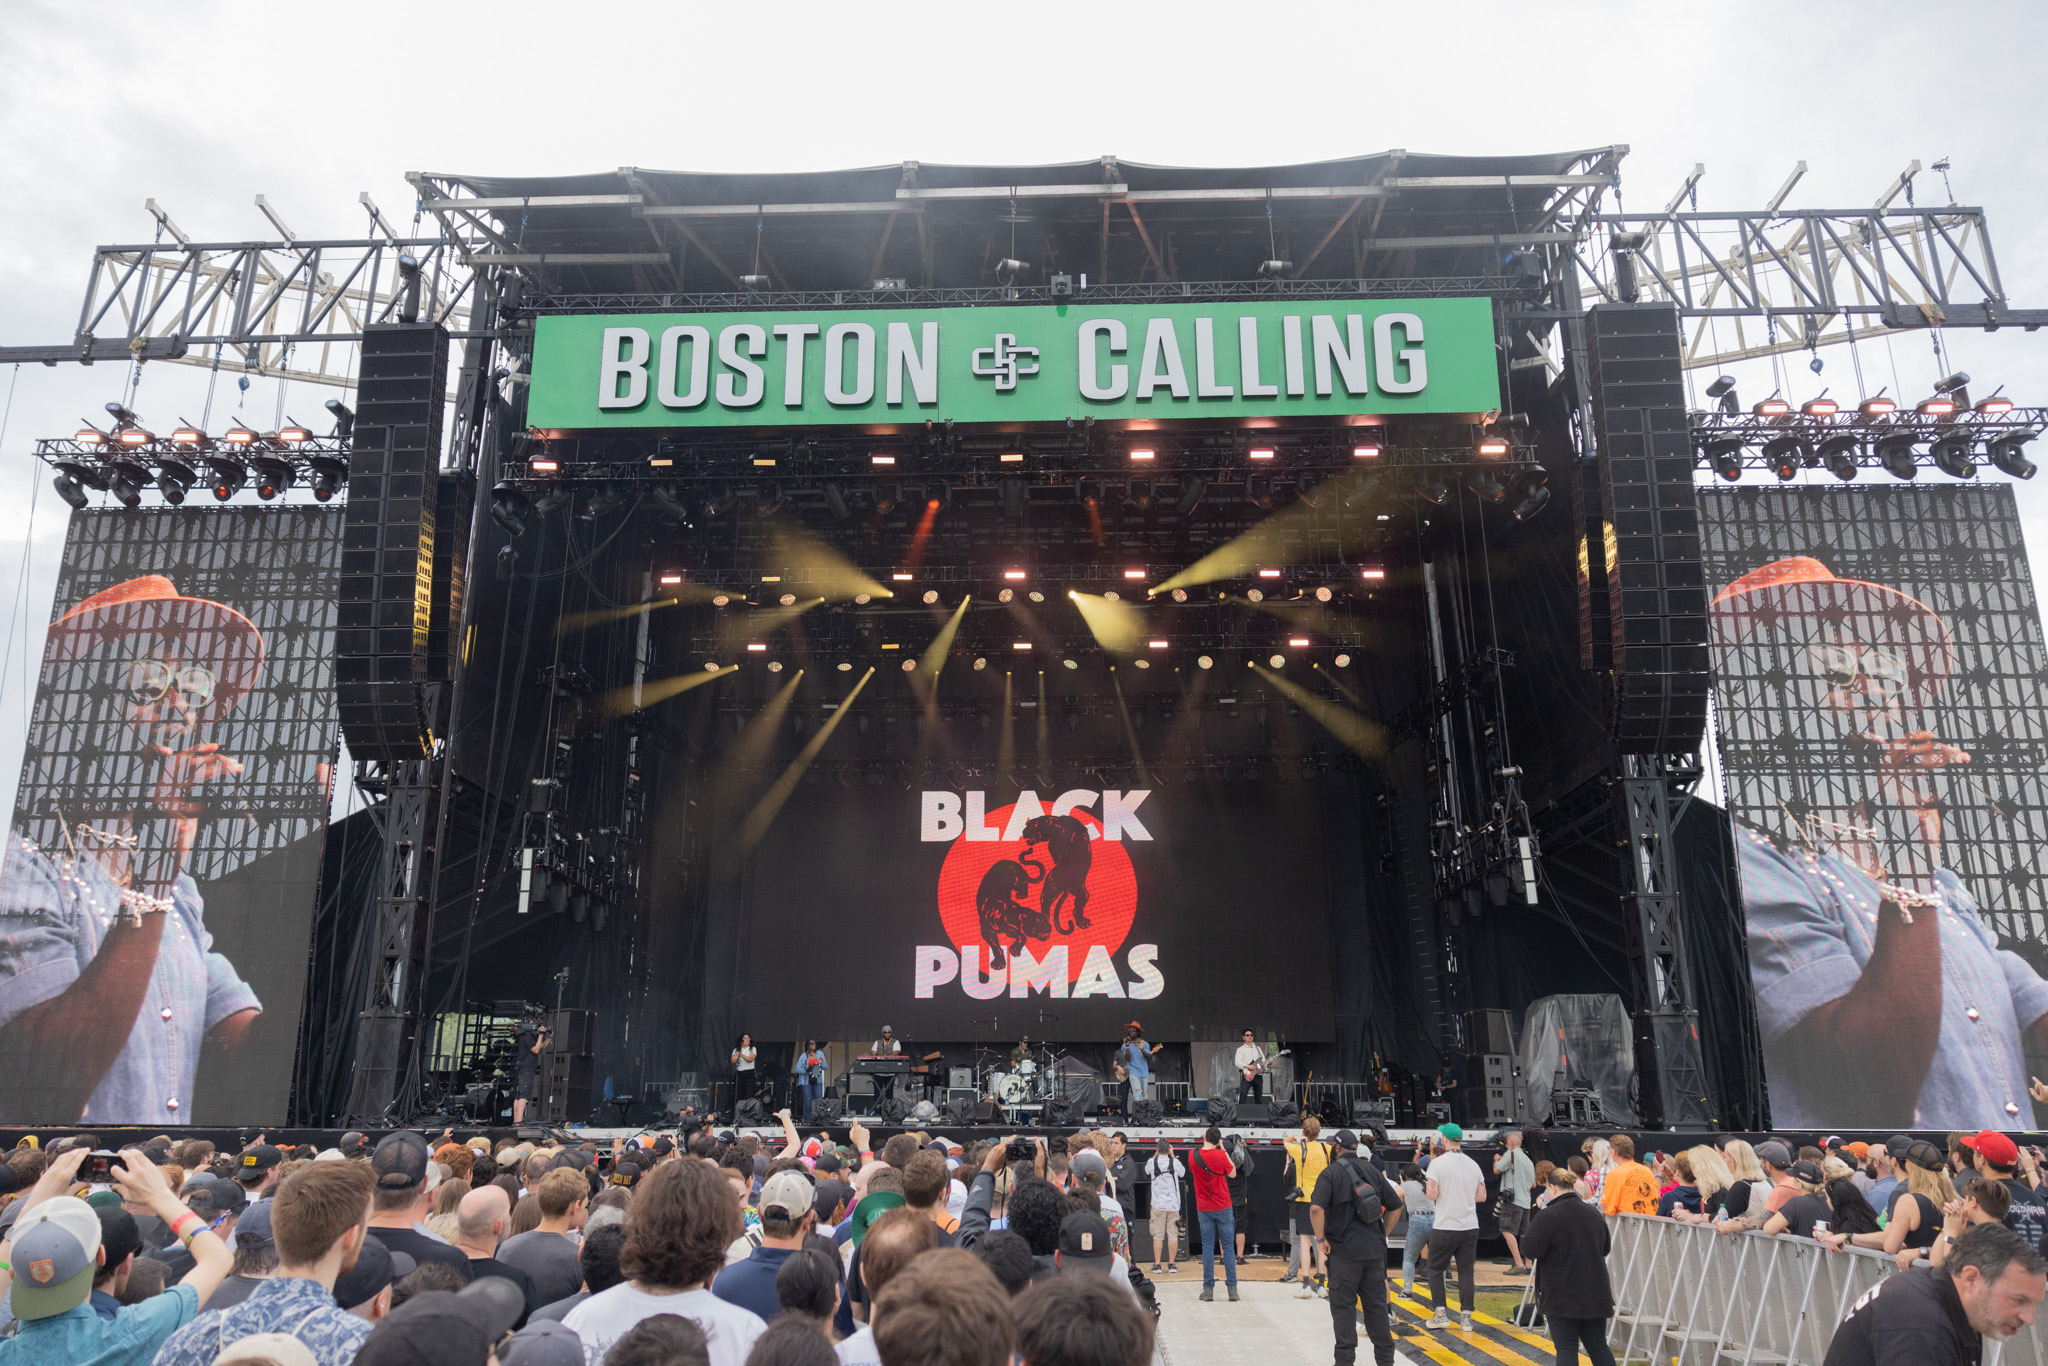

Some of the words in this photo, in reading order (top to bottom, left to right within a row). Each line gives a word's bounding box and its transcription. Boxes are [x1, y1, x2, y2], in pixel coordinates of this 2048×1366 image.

[598, 321, 939, 411] BOSTON
[1078, 312, 1429, 401] CALLING
[921, 789, 1154, 842] BLACK
[915, 943, 1165, 1000] PUMAS
